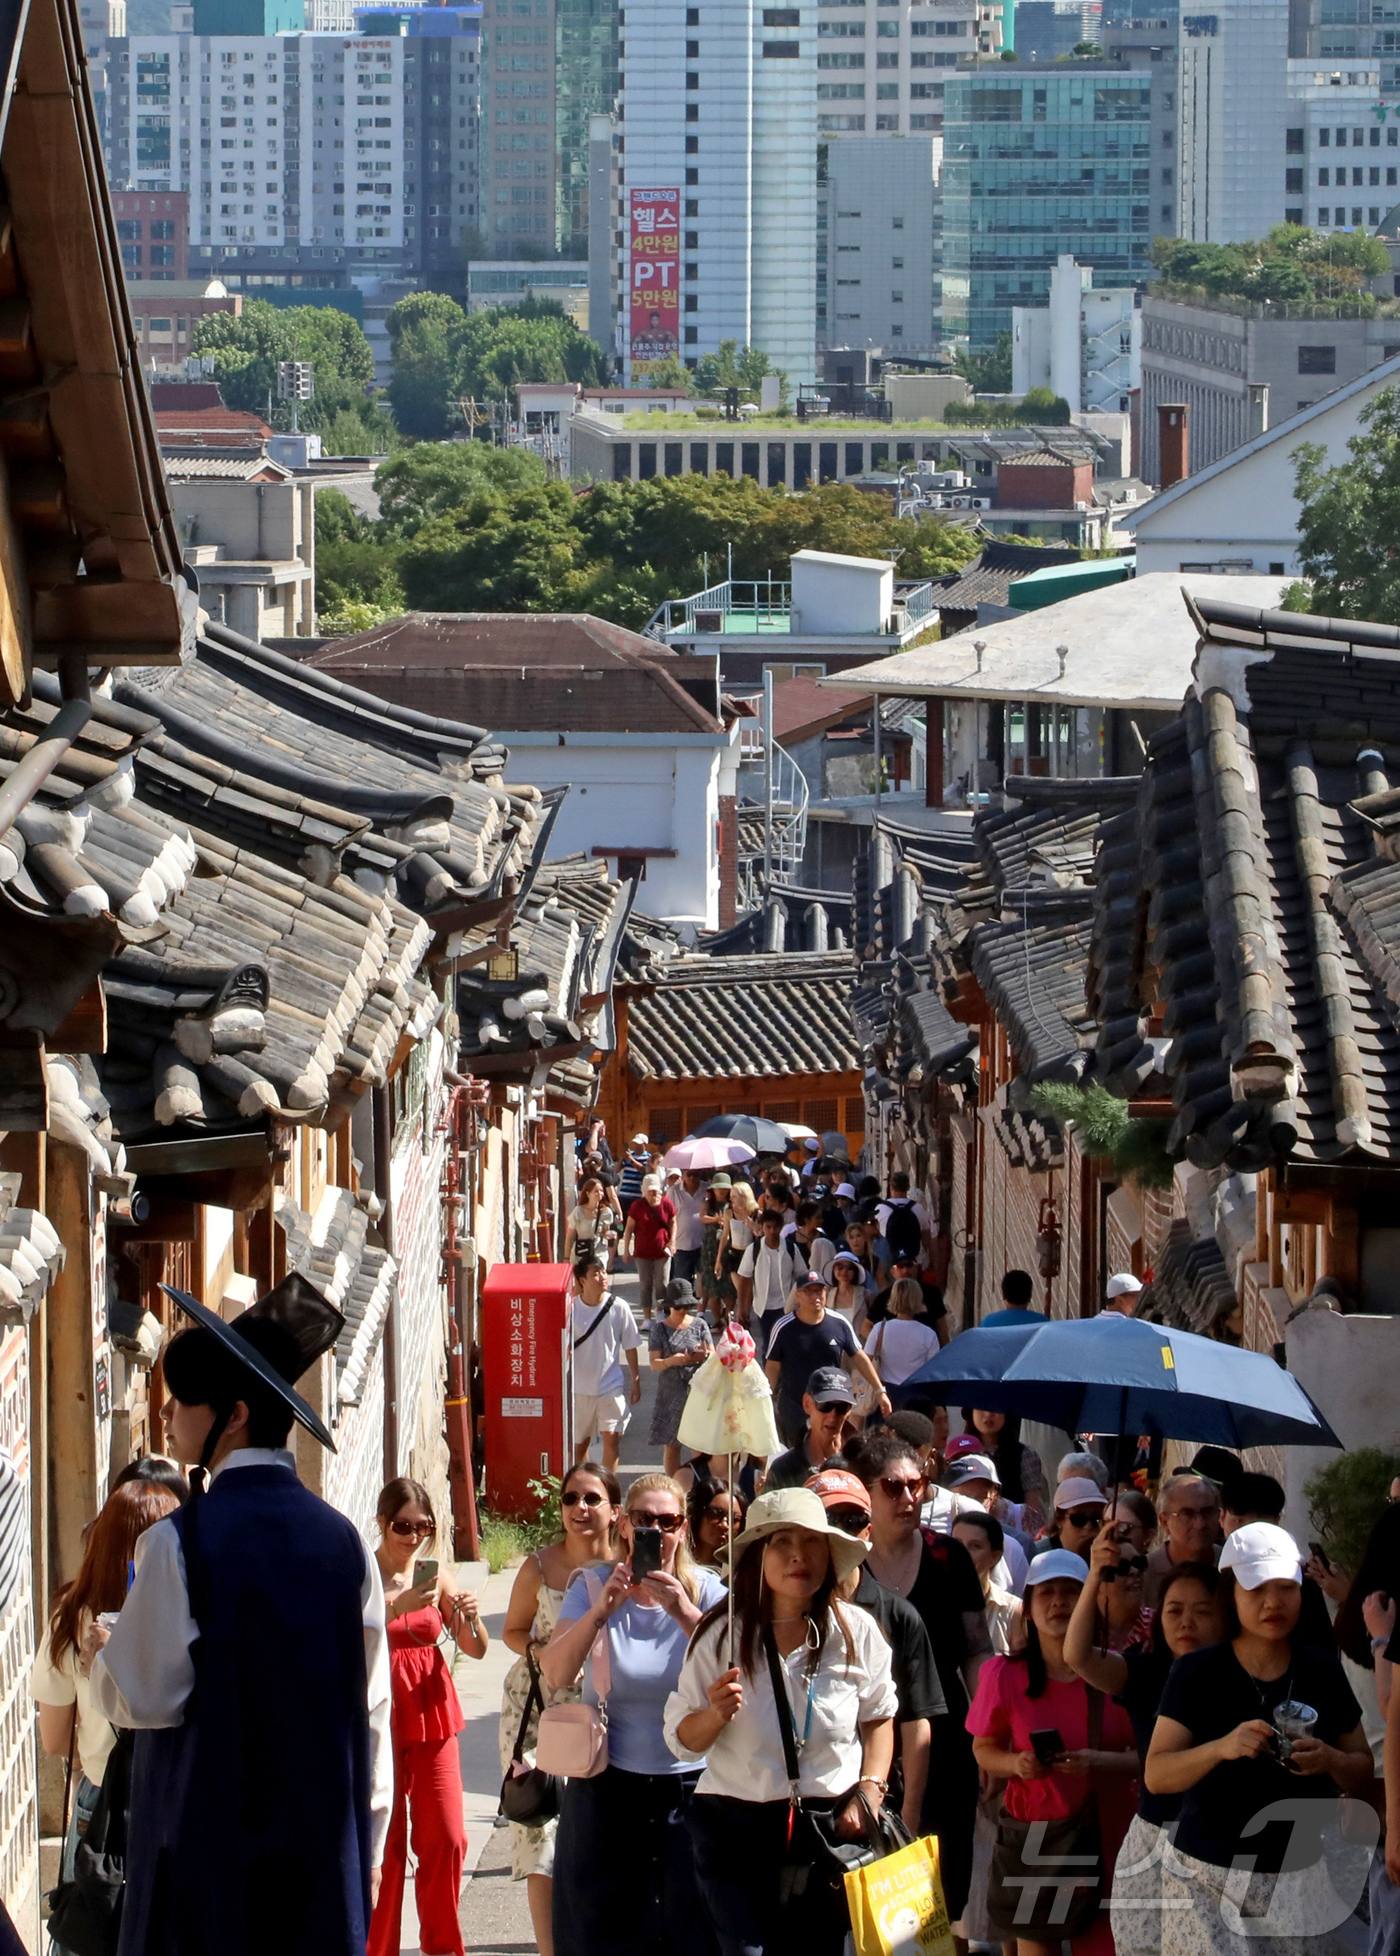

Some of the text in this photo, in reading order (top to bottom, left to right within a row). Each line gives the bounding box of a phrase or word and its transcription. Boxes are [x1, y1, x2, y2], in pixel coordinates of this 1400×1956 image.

[632, 207, 677, 233] 헬스
[632, 235, 678, 254] 4만원
[635, 262, 675, 287] PT
[632, 290, 677, 309] 5만원
[527, 1298, 536, 1340] Emergency
[510, 1297, 523, 1387] 비상소화장치
[528, 1356, 536, 1386] Hydrant
[870, 1859, 931, 1901] I'M LITTLE
[914, 1891, 941, 1915] I LOVE
[920, 1907, 947, 1929] CLEAN
